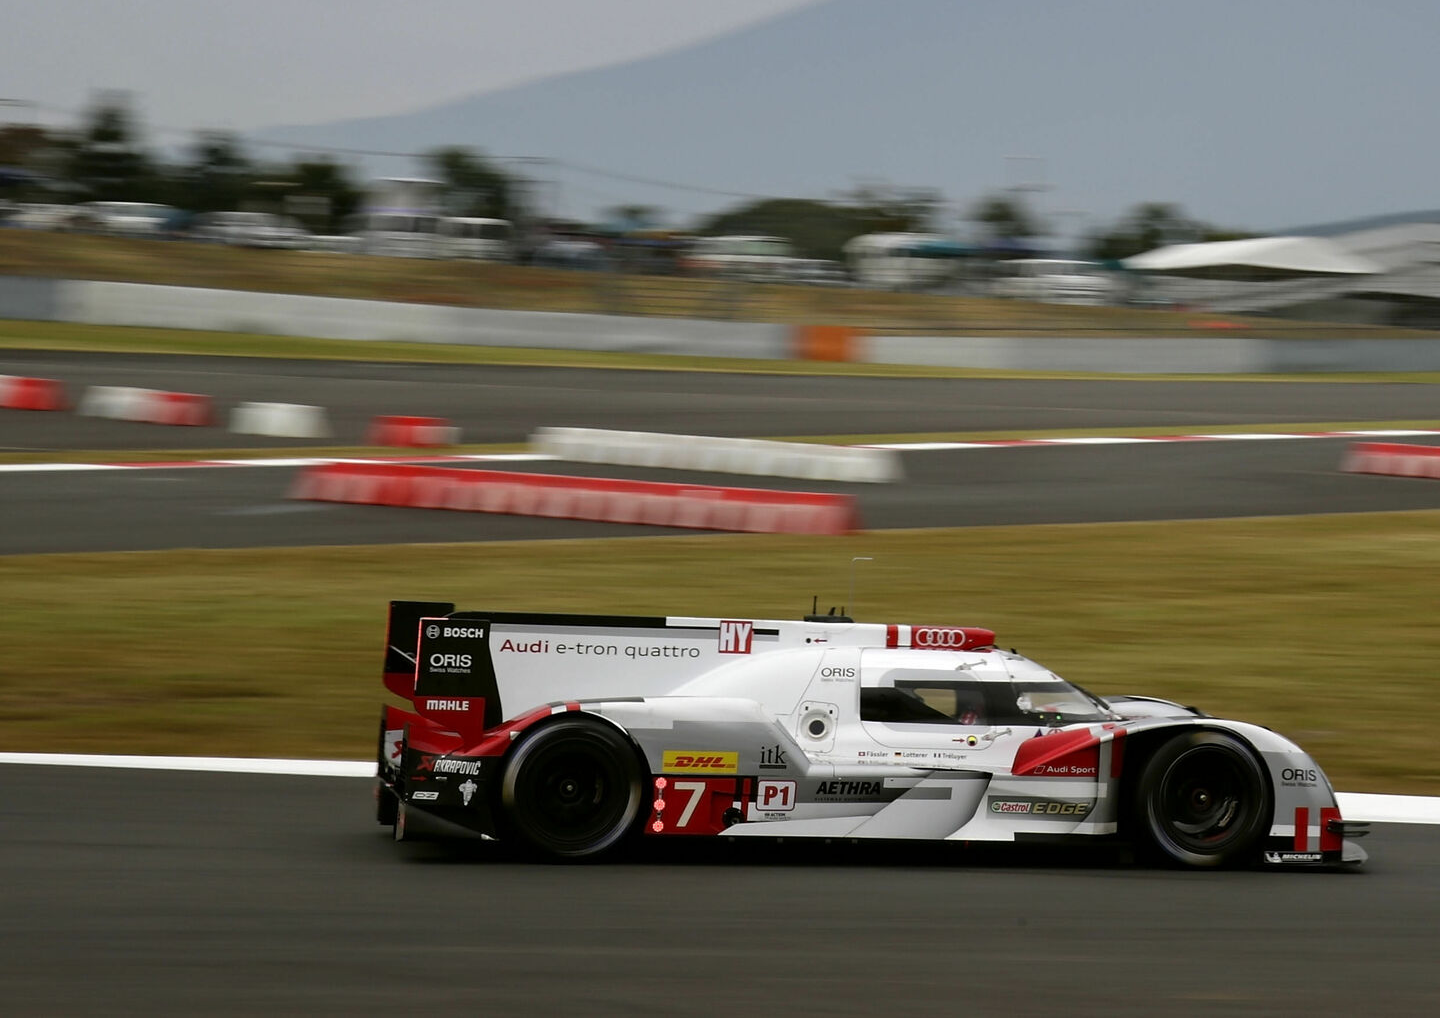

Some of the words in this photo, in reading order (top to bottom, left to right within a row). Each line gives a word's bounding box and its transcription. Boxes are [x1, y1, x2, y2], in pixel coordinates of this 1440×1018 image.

[443, 627, 484, 638] BOSCH
[720, 622, 752, 652] HY
[500, 638, 549, 654] Audi
[556, 641, 618, 656] e-tron
[624, 646, 701, 659] quattro
[430, 653, 472, 667] ORIS
[821, 667, 855, 678] ORIS
[426, 699, 469, 711] MAHLE
[760, 745, 787, 764] itk
[674, 756, 726, 768] DHL
[1046, 765, 1068, 773] Audi
[1071, 766, 1096, 774] Sport
[1282, 768, 1317, 782] ORIS
[816, 781, 881, 795] AETHRA
[763, 785, 790, 806] P1
[674, 782, 706, 827] 7
[1001, 802, 1029, 812] Castrol
[1032, 802, 1090, 814] EDGE
